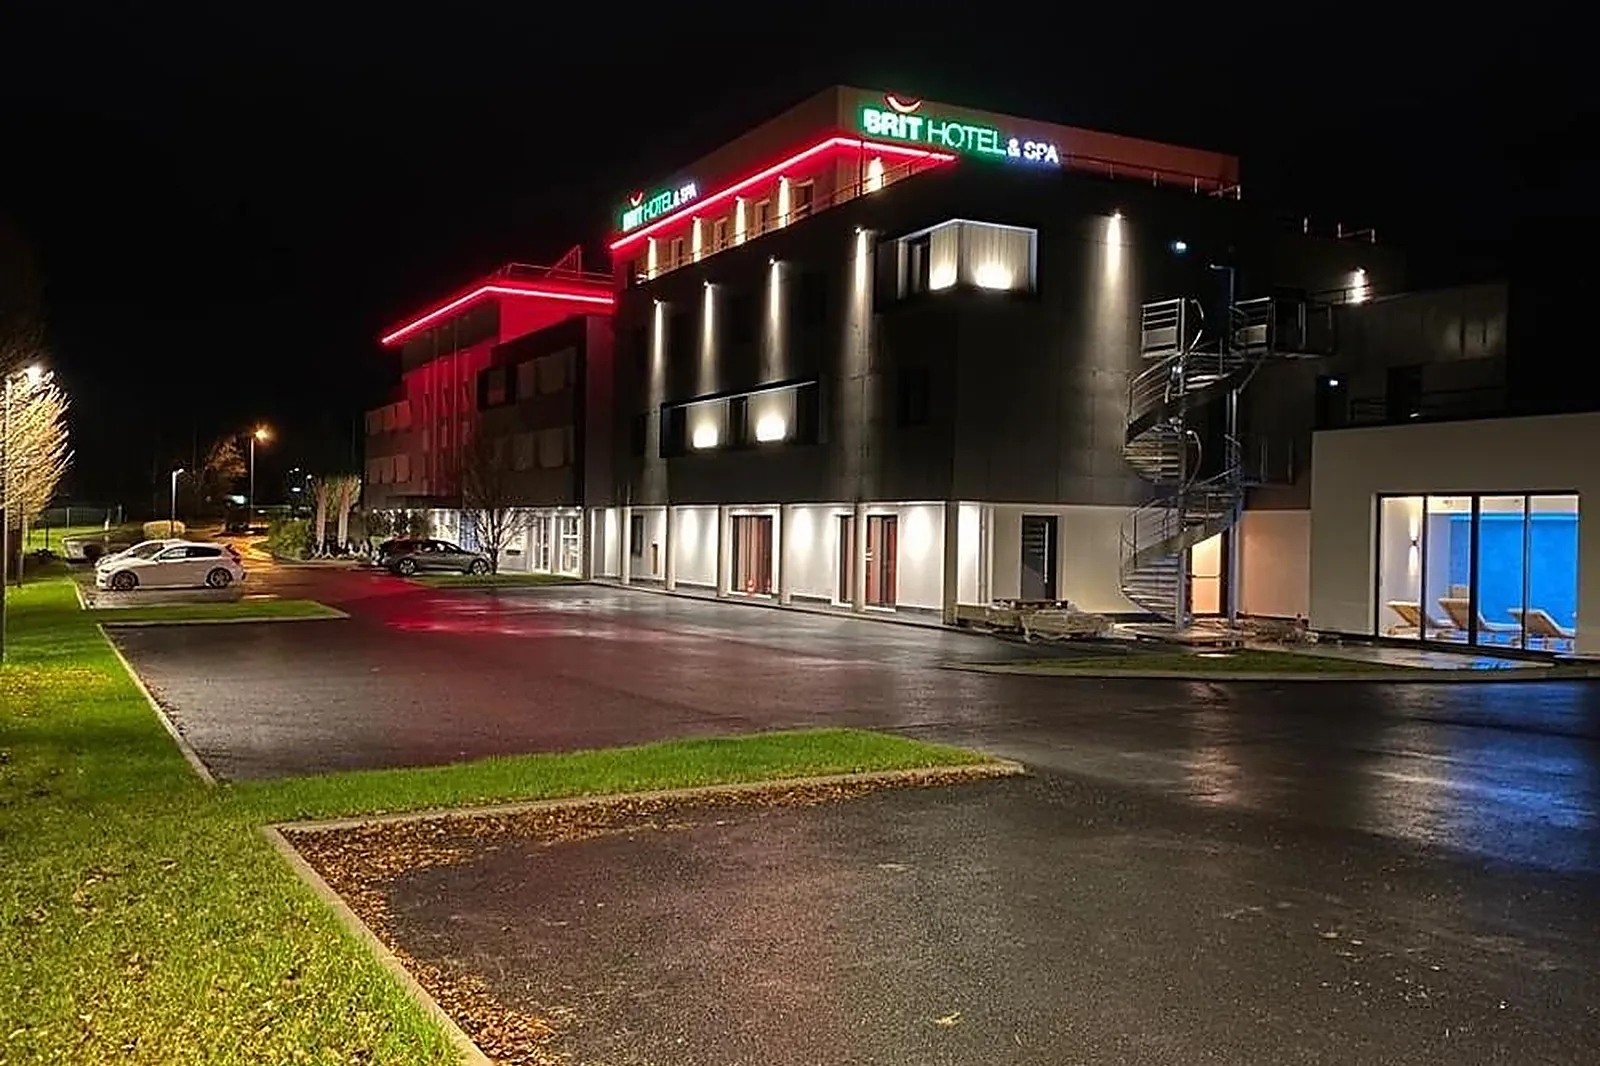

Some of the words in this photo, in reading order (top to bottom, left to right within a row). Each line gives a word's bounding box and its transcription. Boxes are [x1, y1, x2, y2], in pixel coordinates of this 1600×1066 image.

[863, 108, 923, 140] BRIT
[928, 119, 1006, 155] HOTEL
[1007, 138, 1020, 158] &
[1023, 141, 1059, 163] SPA
[643, 191, 675, 222] HOTEL
[680, 182, 697, 204] SPA
